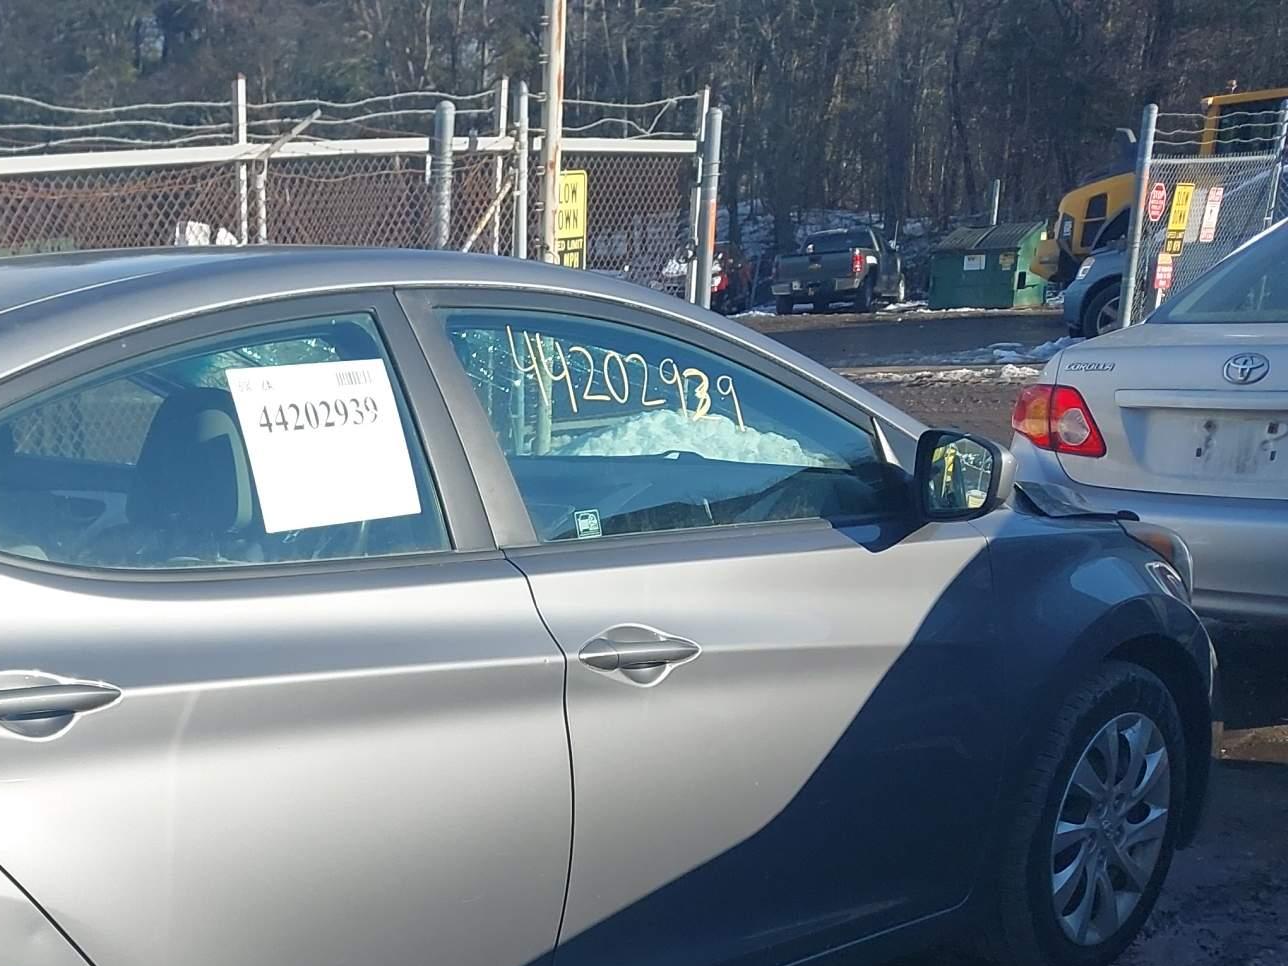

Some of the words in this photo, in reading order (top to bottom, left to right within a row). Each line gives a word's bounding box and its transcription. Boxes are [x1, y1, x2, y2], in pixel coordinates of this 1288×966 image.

[558, 183, 578, 204] LOW
[557, 209, 579, 230] OWN
[1064, 362, 1116, 372] COROLLA
[506, 325, 746, 433] 44202939
[259, 396, 379, 433] 44202939
